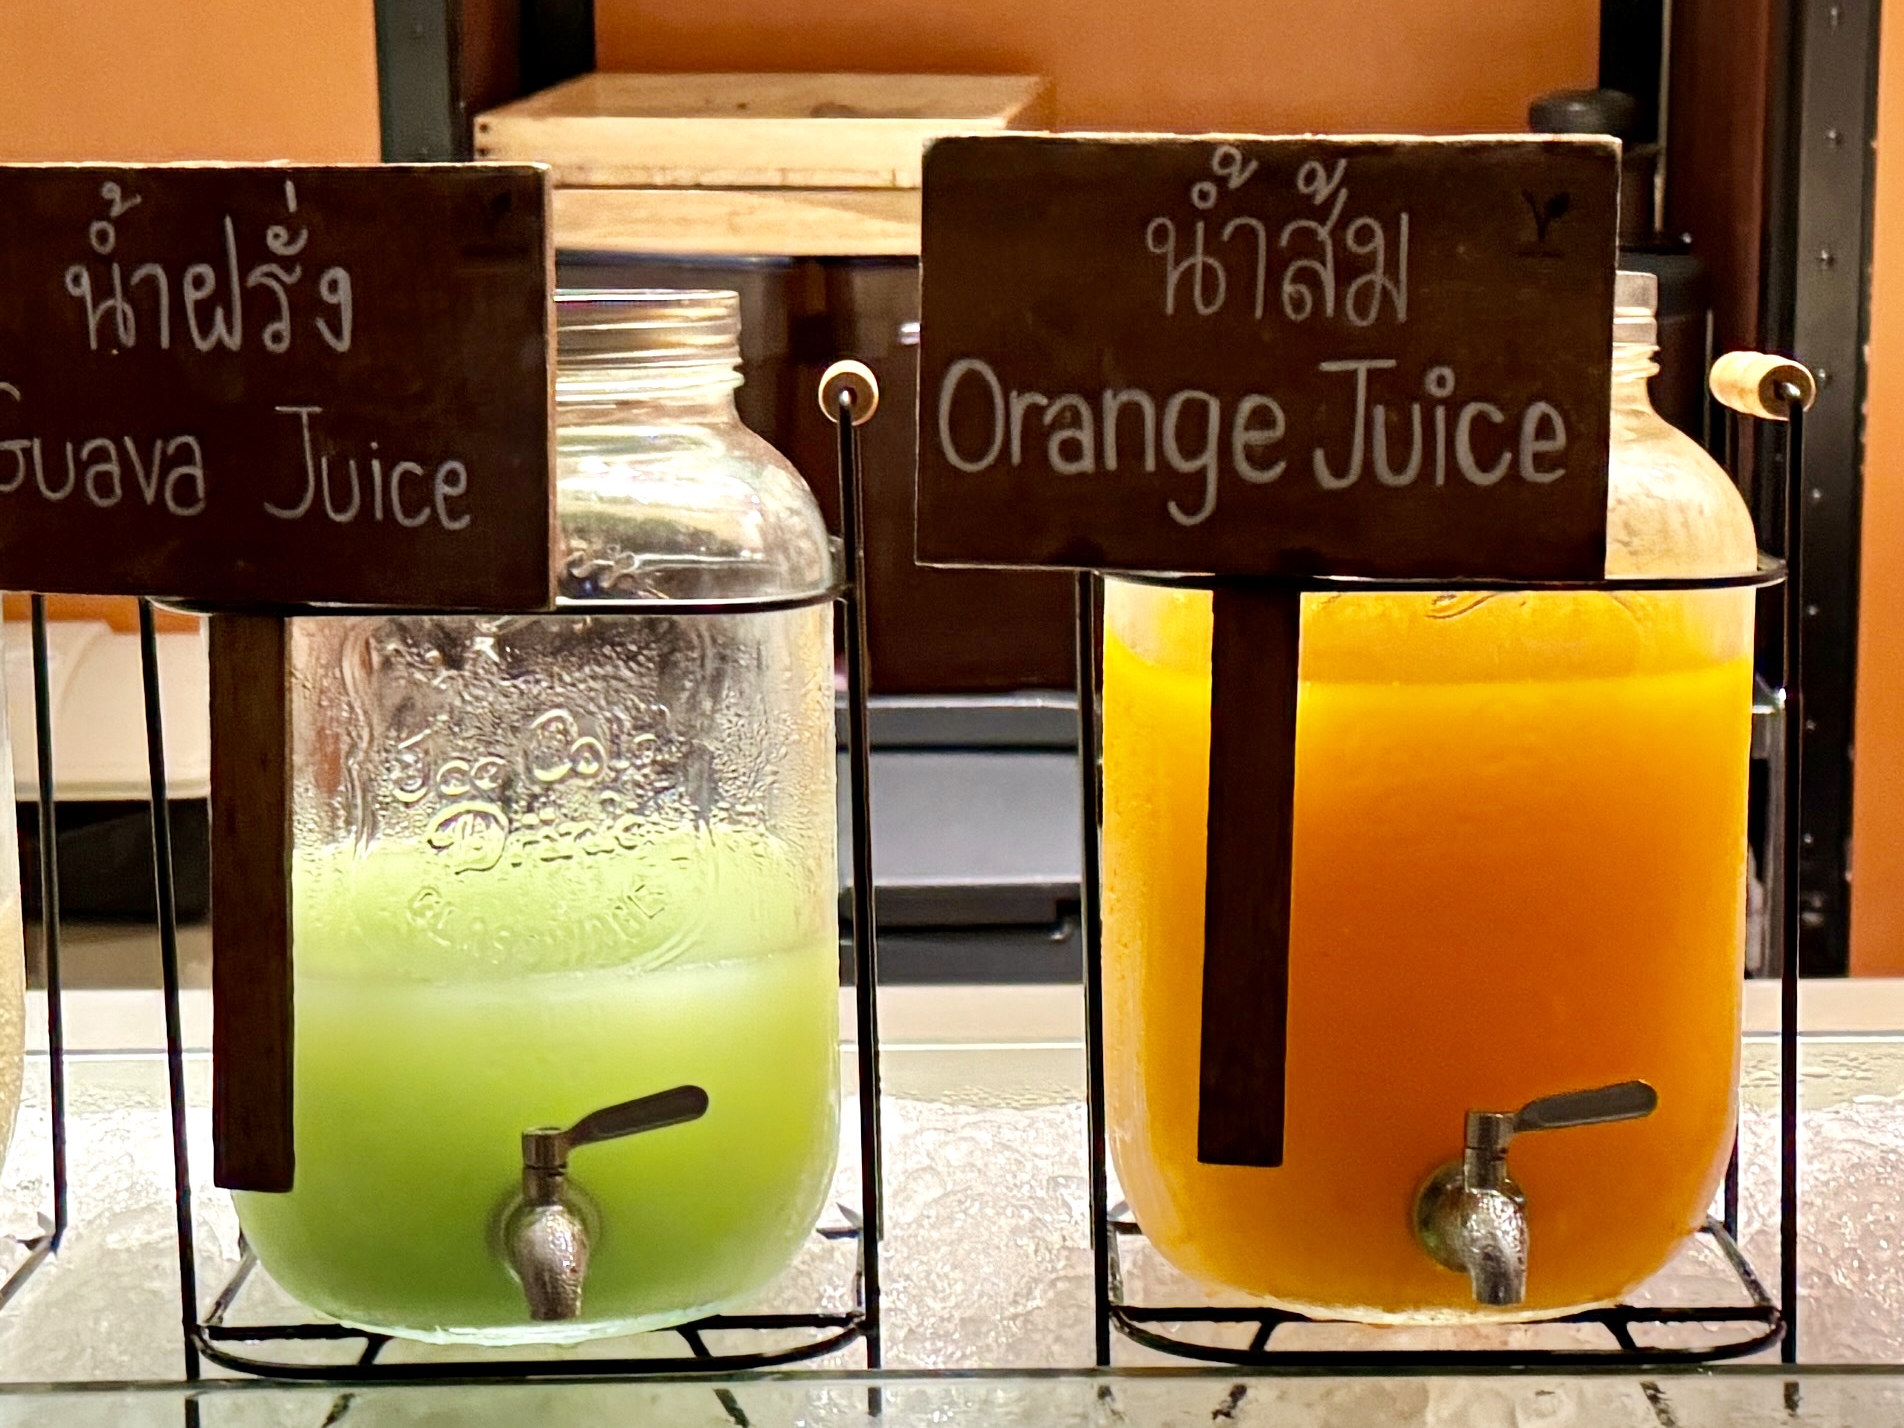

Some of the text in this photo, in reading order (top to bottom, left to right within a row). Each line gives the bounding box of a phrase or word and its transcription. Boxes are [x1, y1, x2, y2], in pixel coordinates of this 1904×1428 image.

[64, 179, 353, 352] น้ำฝรั่ง
[1145, 144, 1410, 326] น้ำส้ม
[263, 405, 471, 530] Juice
[938, 358, 1567, 526] Orange Juice
